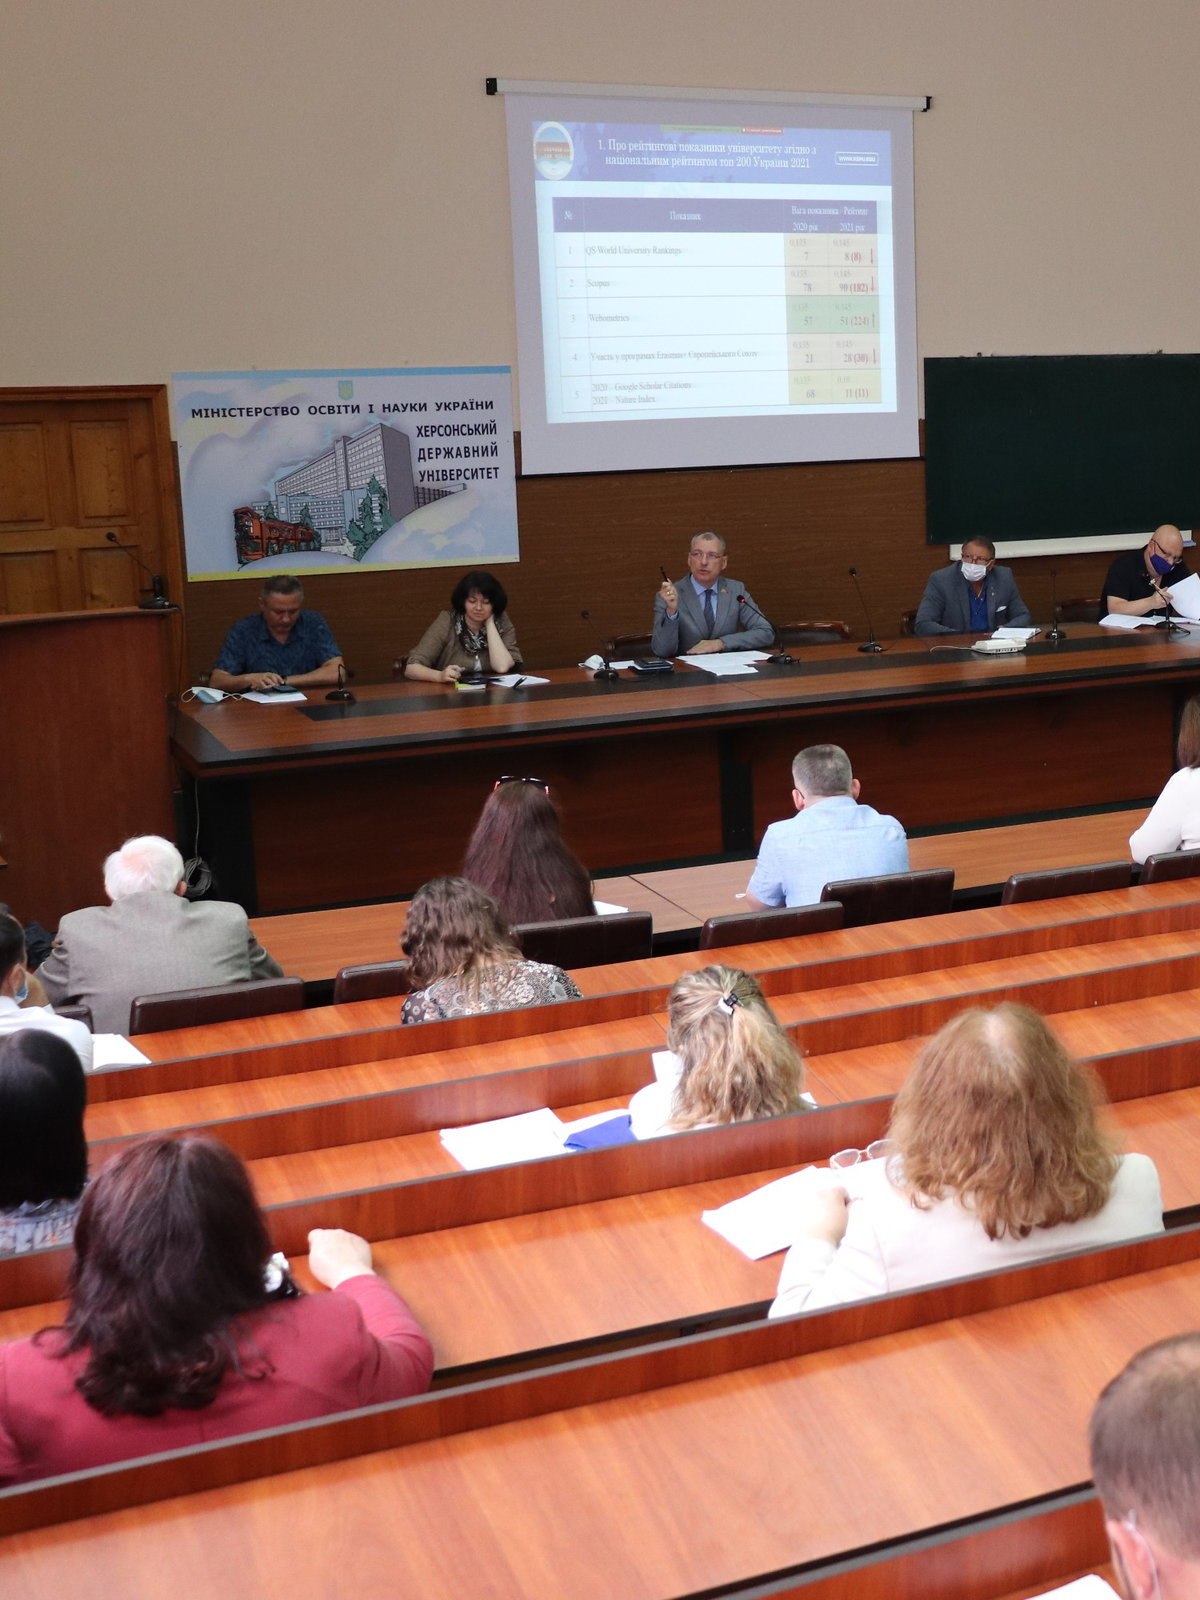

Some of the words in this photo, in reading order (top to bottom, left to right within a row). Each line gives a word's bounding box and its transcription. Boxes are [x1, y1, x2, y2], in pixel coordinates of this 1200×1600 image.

[608, 138, 628, 153] Про
[628, 140, 677, 153] рейтингові
[679, 142, 726, 154] показники
[727, 142, 782, 156] університету
[784, 144, 811, 155] згідно
[605, 154, 669, 167] національним
[671, 156, 718, 168] рейтингом
[720, 159, 734, 168] топ
[736, 156, 752, 168] 200
[753, 156, 789, 170] України
[790, 157, 810, 169] 2021
[793, 222, 808, 232] 2020
[840, 222, 854, 232] 2021
[585, 246, 597, 257] QS
[597, 245, 617, 255] World
[618, 245, 651, 257] University
[652, 246, 682, 257] Rankings
[586, 278, 610, 289] Scopus
[588, 313, 629, 323] Webometrics
[590, 351, 614, 361] Участь
[621, 352, 655, 363] програмах
[591, 383, 608, 393] 2020
[614, 381, 638, 393] Google
[639, 380, 662, 391] Scholar
[663, 381, 692, 390] Citations
[592, 396, 608, 405] 2021
[615, 395, 637, 404] Nature
[638, 394, 656, 404] Index
[191, 405, 300, 419] МІНІСТЕРСТВО
[307, 403, 361, 416] ОСВІТИ
[368, 404, 374, 414] І
[382, 402, 428, 414] НАУКИ
[435, 400, 495, 413] УКРАЇНИ
[416, 420, 498, 438] ХЕРСОНСЬКИЙ
[417, 443, 499, 463] ДЕРЖАВНИЙ
[419, 467, 500, 483] УНІВЕРСИТЕТ
